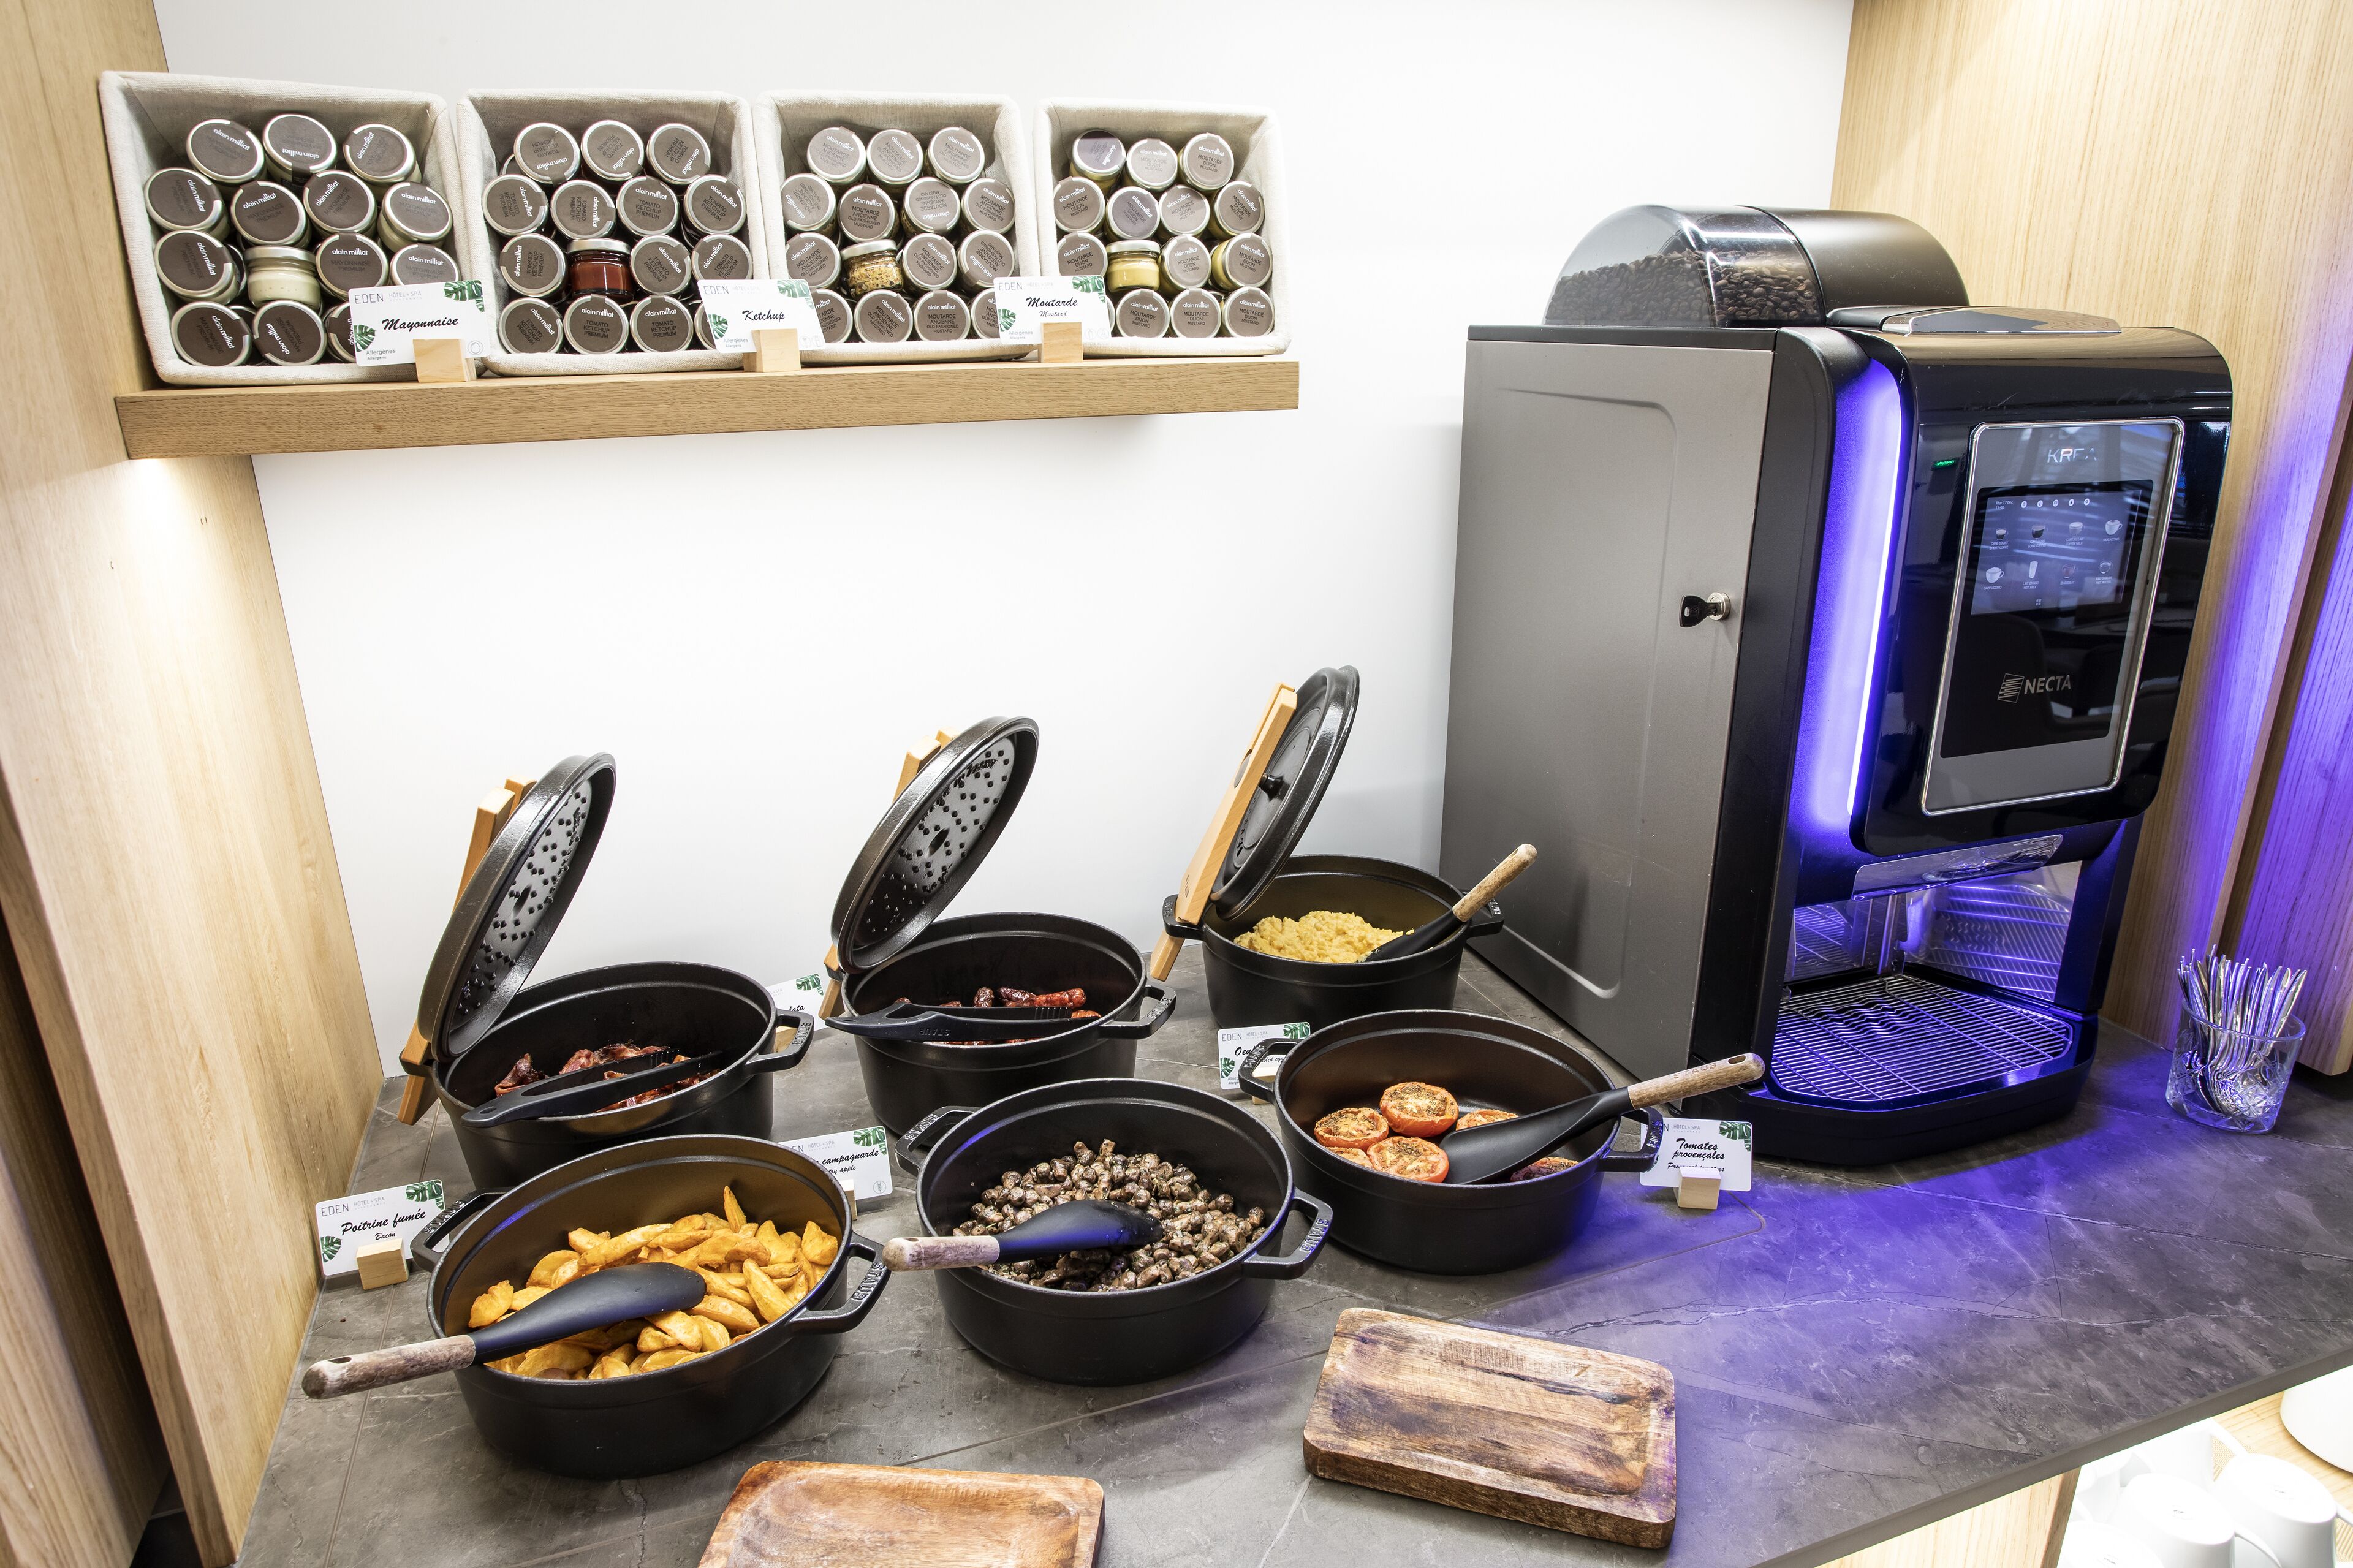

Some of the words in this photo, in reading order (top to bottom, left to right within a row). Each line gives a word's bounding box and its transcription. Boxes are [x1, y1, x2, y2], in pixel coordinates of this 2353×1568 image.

[214, 129, 230, 140] alain
[229, 135, 250, 151] milliat
[1197, 154, 1224, 165] MOUTARDE
[316, 194, 327, 206] alain
[325, 180, 339, 197] milliat
[650, 191, 667, 200] milliat
[1071, 187, 1085, 197] milliat
[243, 200, 259, 209] alain
[258, 193, 276, 204] milliat
[417, 195, 436, 204] milliat
[638, 199, 661, 209] TOMATO
[1063, 195, 1089, 210] MOUTARDE
[635, 204, 662, 214] KETCHUP
[852, 206, 880, 216] MOUTARDE
[1070, 206, 1089, 216] MUSTARD
[1071, 203, 1085, 212] DIJON
[636, 210, 660, 219] PREMIUM
[853, 211, 877, 221] ANCIENNE
[857, 218, 881, 226] FASHIONED
[197, 242, 207, 257] alain
[203, 256, 216, 276] milliat
[703, 286, 729, 295] EDEN
[999, 282, 1023, 291] EDEN
[355, 293, 384, 304] EDEN
[1026, 297, 1078, 308] Moutarde
[742, 309, 786, 323] Ketchup
[382, 317, 458, 332] Mayonnaise
[212, 316, 223, 332] alain
[221, 330, 235, 349] milliat
[2024, 675, 2071, 694] NECTA
[1222, 1033, 1242, 1042] EDEN
[1676, 1138, 1718, 1151] Tomates
[822, 1148, 879, 1165] campagnarde
[1672, 1150, 1725, 1161] provençales
[839, 1165, 857, 1173] apple
[321, 1203, 349, 1217] EDEN
[341, 1220, 388, 1236] Poitrine
[393, 1208, 426, 1228] fumée
[375, 1232, 396, 1240] Bacon
[1299, 1218, 1329, 1252] STAUB
[851, 1262, 887, 1301] STAUB
